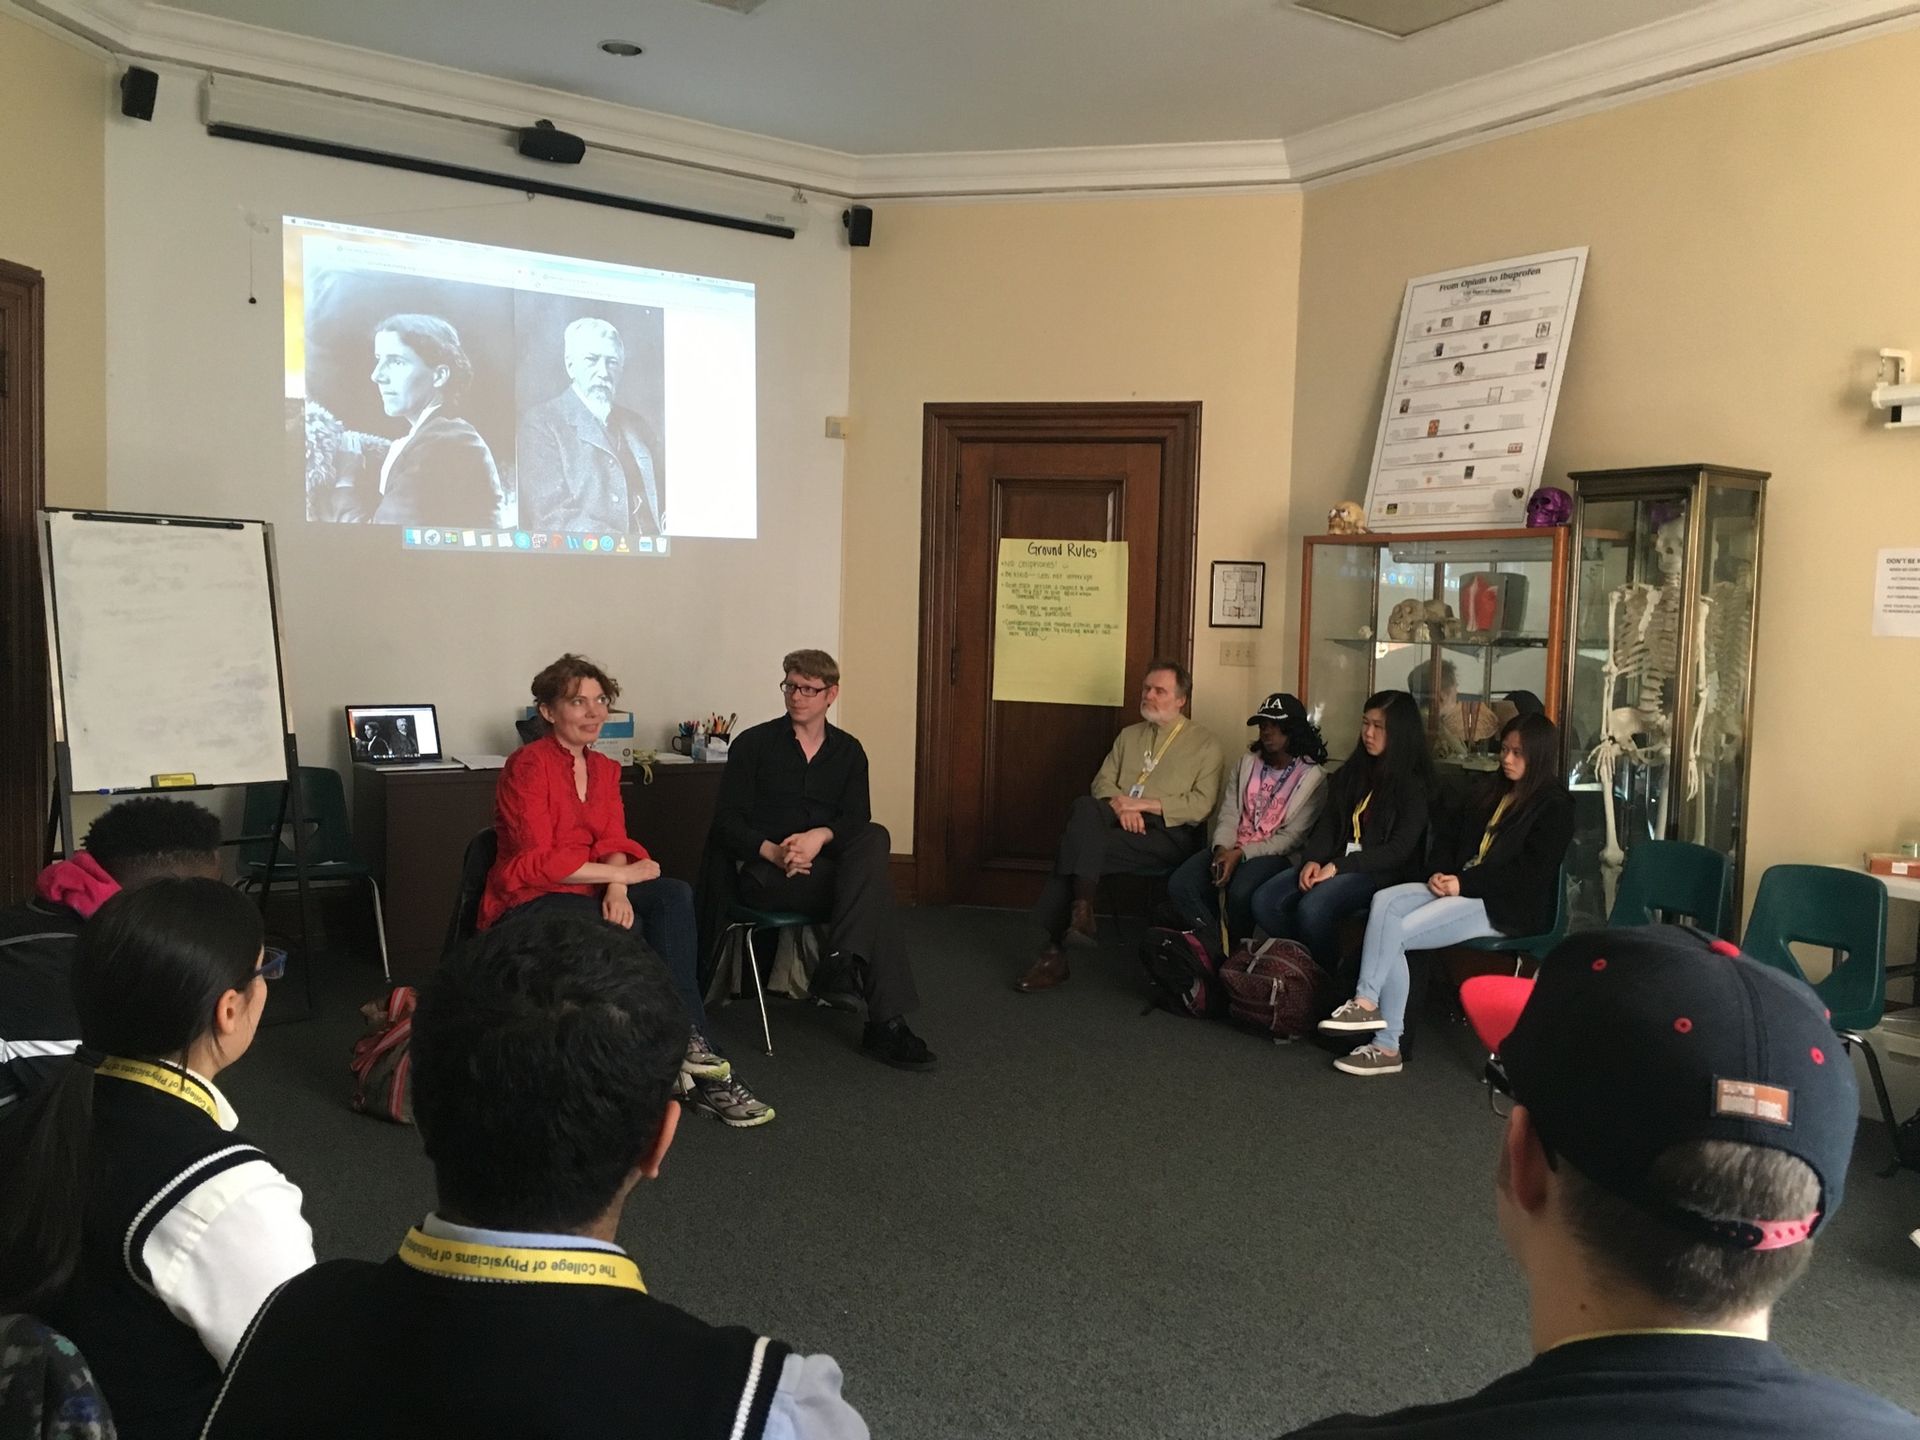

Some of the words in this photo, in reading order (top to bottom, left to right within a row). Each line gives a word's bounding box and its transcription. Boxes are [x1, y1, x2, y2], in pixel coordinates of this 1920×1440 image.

[1439, 282, 1459, 292] From
[1461, 277, 1487, 289] Opium
[1489, 275, 1498, 283] to
[1500, 267, 1541, 282] Ibuprofen
[1028, 541, 1062, 557] Ground
[1067, 542, 1098, 559] Rules
[440, 1250, 452, 1262] of
[456, 1252, 529, 1273] Physicians
[532, 1259, 547, 1273] of
[551, 1258, 597, 1277] College
[599, 1263, 617, 1279] The
